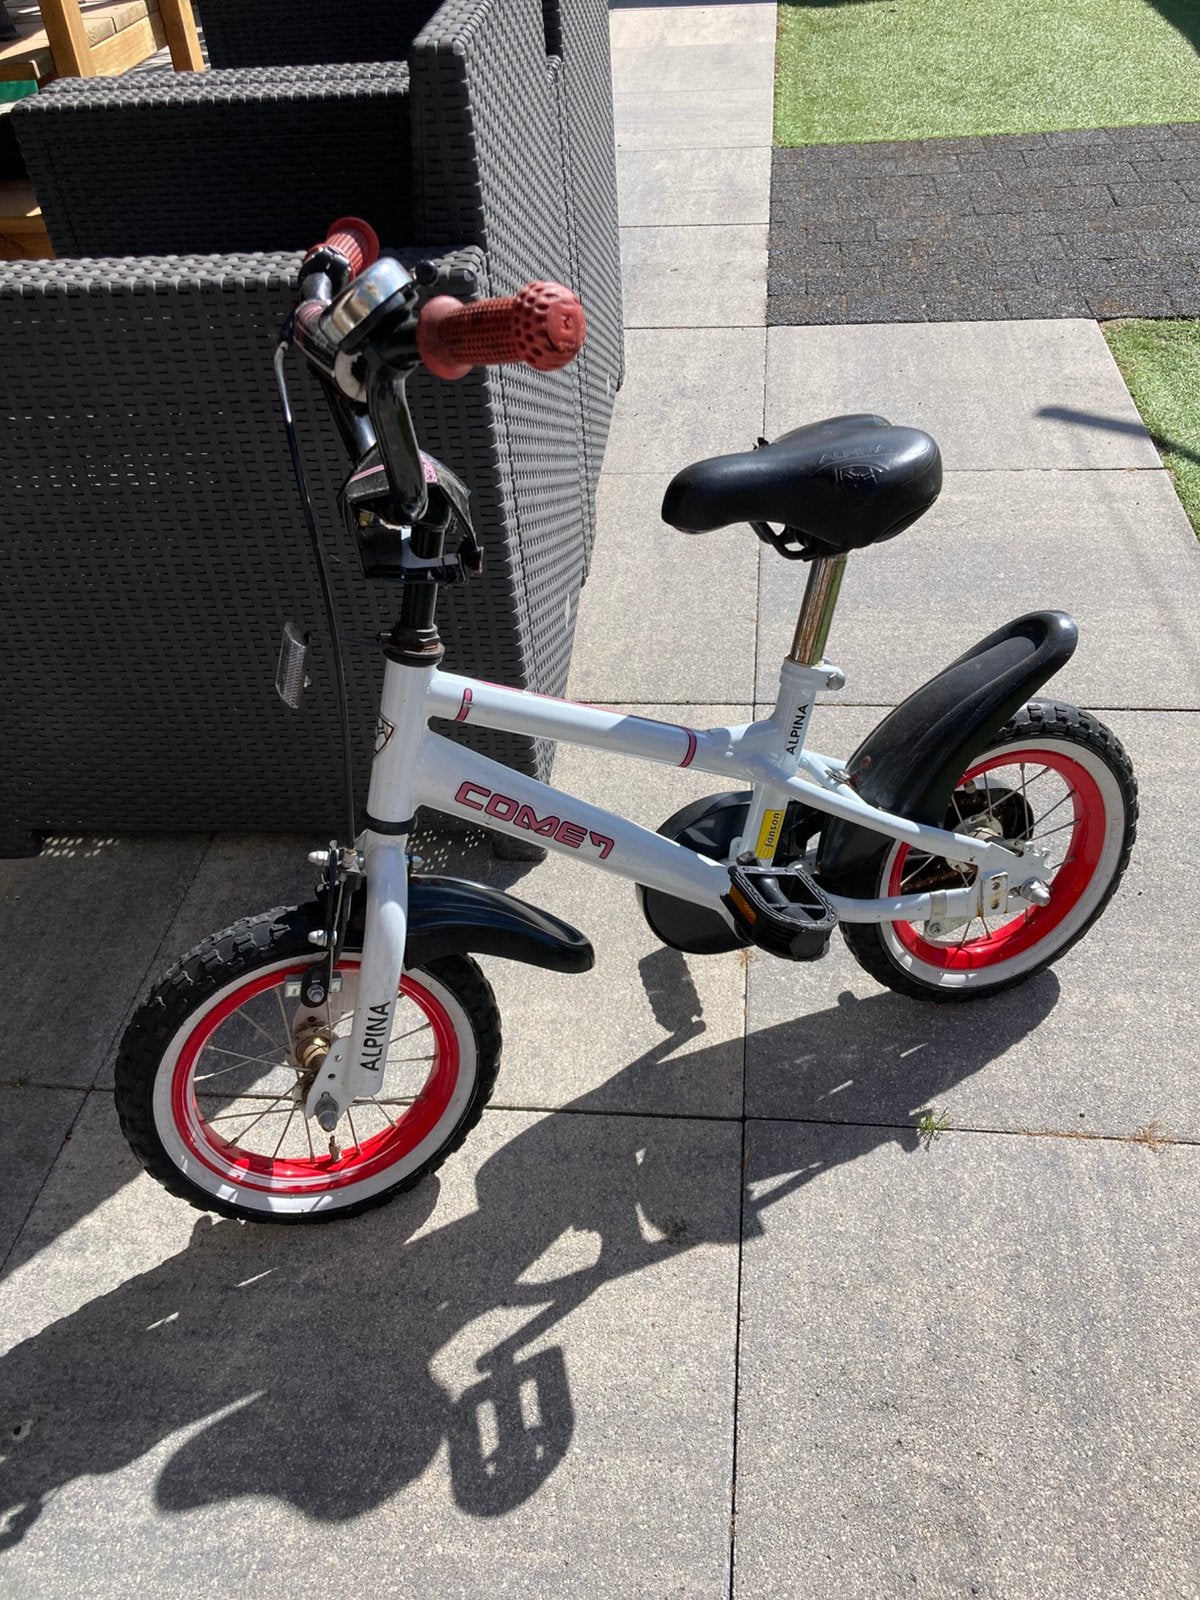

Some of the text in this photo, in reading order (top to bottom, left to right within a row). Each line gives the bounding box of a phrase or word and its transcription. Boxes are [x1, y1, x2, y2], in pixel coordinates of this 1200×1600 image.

[786, 704, 809, 756] ALPINA
[454, 780, 615, 860] COMET
[360, 1000, 391, 1072] ALPINA
